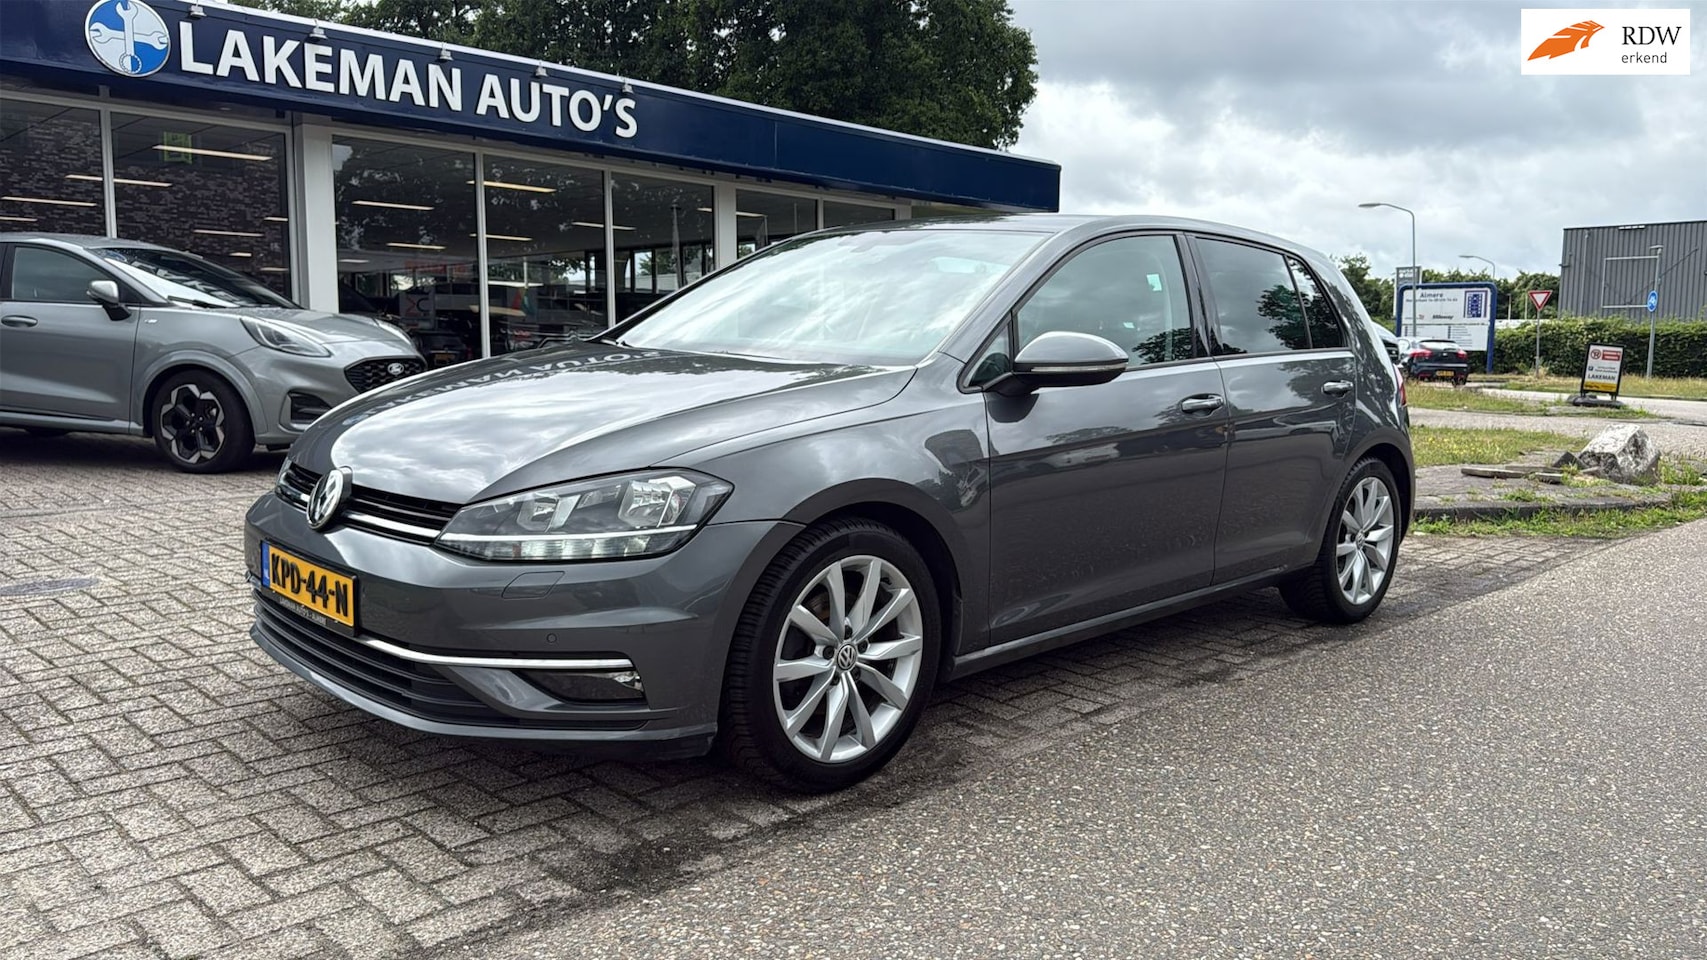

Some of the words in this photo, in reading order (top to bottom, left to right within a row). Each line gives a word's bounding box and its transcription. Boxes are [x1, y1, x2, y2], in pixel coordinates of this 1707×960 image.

[178, 21, 463, 112] LAKEMAN
[475, 73, 638, 138] AUTO'S
[1587, 373, 1616, 381] LAKEMAN
[271, 552, 349, 617] KPD-44-N
